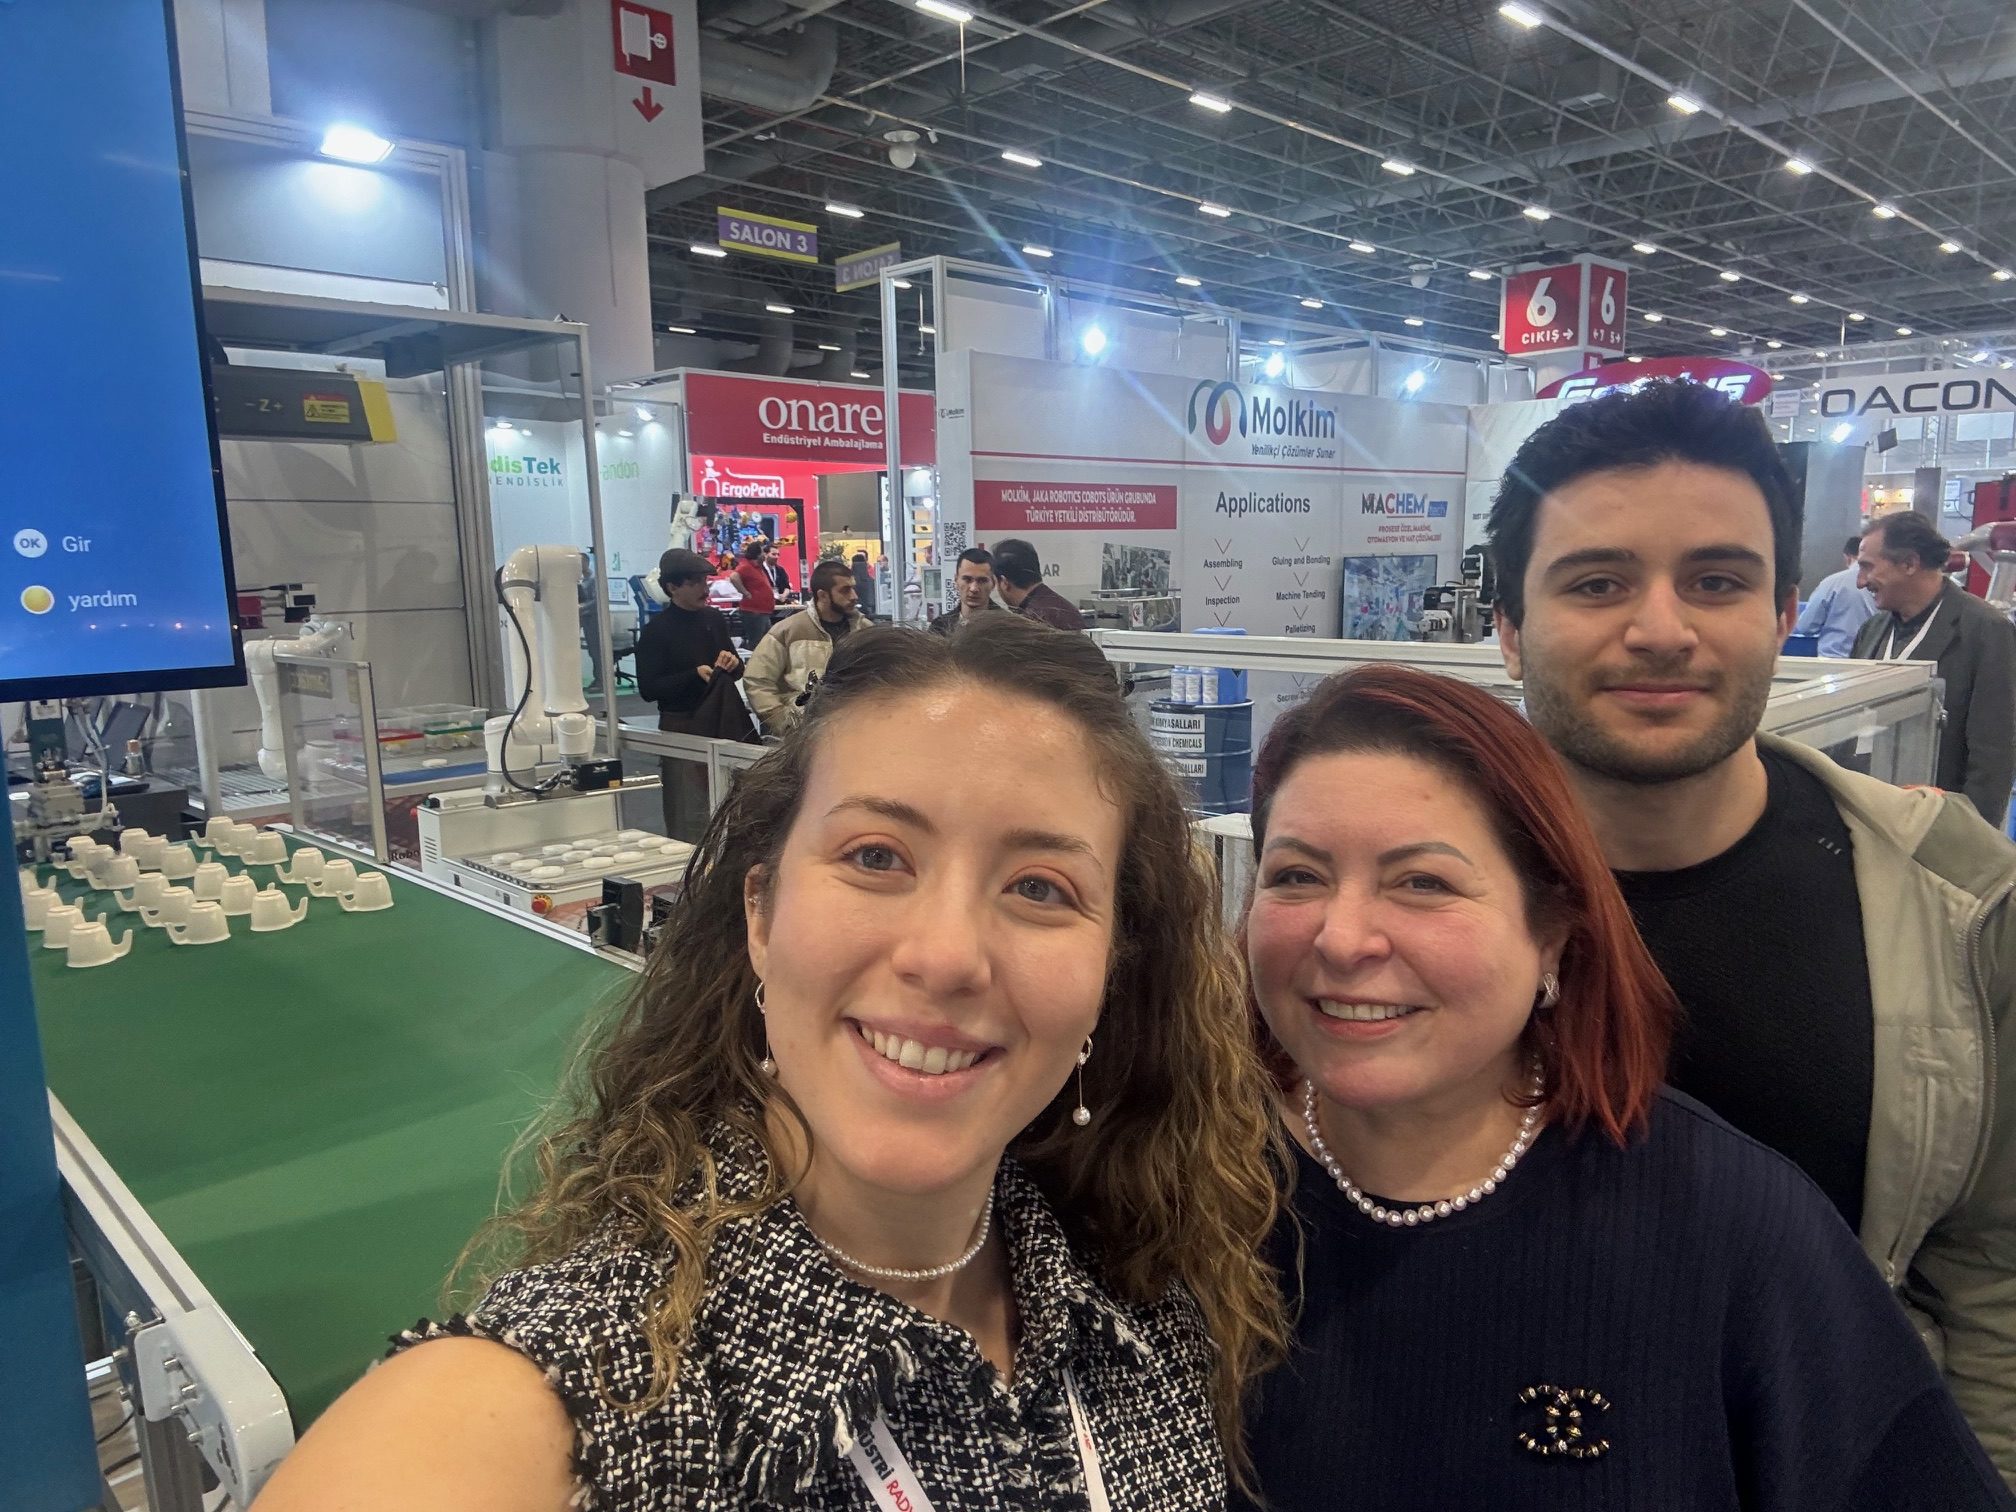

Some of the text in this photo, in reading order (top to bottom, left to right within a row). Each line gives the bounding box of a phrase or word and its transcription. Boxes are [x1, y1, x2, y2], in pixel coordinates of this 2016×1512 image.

[730, 221, 808, 253] SALON 3
[1526, 277, 1557, 327] 6
[1601, 276, 1615, 325] 6
[758, 397, 883, 436] onare
[1252, 396, 1335, 438] Molkim
[763, 433, 883, 450] Endüstriyel Ambalajlama
[1281, 445, 1315, 460] Çözümler
[721, 482, 779, 498] ErgoPack
[1033, 490, 1049, 503] JAKA
[1050, 490, 1081, 503] ROBOTICS
[1081, 491, 1106, 503] COBOTS
[1125, 492, 1156, 504] GRUBUNDA
[1216, 491, 1311, 518] Applications
[1361, 492, 1425, 514] MACHEM
[1025, 506, 1054, 522] TÜRKİYE
[1055, 506, 1078, 522] YETKİLİ
[19, 538, 41, 548] OK
[62, 536, 92, 552] Gir
[1204, 559, 1243, 569] Assembling
[1294, 557, 1305, 565] and
[1306, 555, 1331, 566] Bonding
[1041, 563, 1060, 576] AR
[68, 590, 137, 612] yardım
[1205, 595, 1240, 607] Inspection
[1276, 590, 1326, 600] Machine Tending
[1285, 624, 1316, 634] Palletizing
[1172, 738, 1202, 748] CHEMICALS
